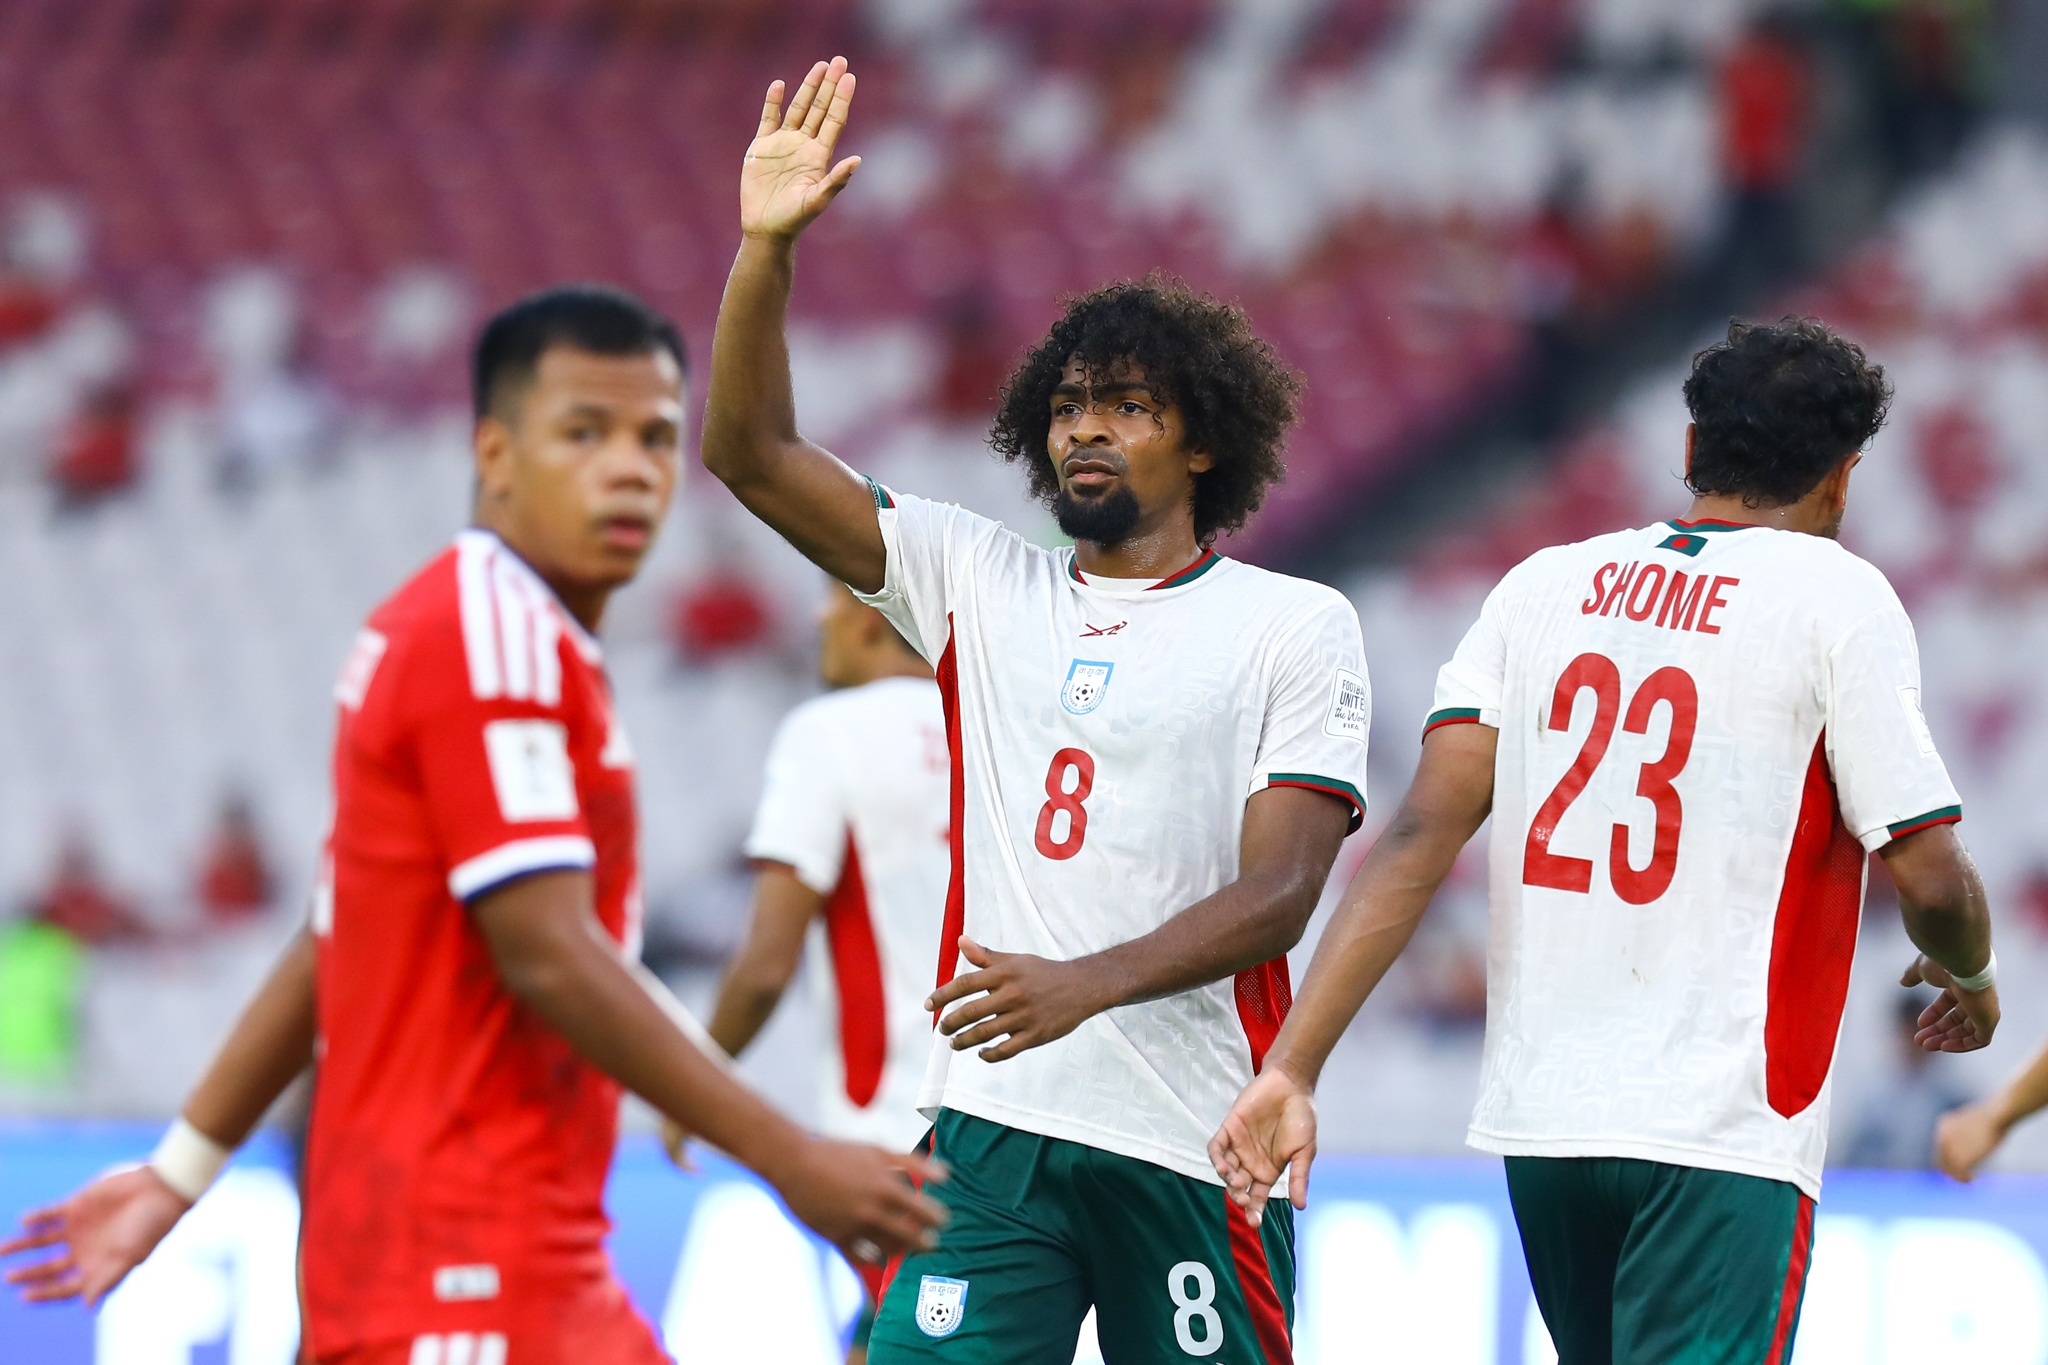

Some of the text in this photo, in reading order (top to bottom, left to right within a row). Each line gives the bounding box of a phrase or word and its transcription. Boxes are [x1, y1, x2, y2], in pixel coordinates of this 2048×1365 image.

[1581, 560, 1740, 635] SHOME
[1340, 690, 1365, 711] UNITE
[1341, 679, 1365, 698] FOOTBA
[1334, 706, 1367, 726] the Worl
[1343, 722, 1360, 731] FIFA
[1522, 652, 1698, 906] 23
[1034, 747, 1095, 861] 8
[1167, 1260, 1224, 1357] 8
